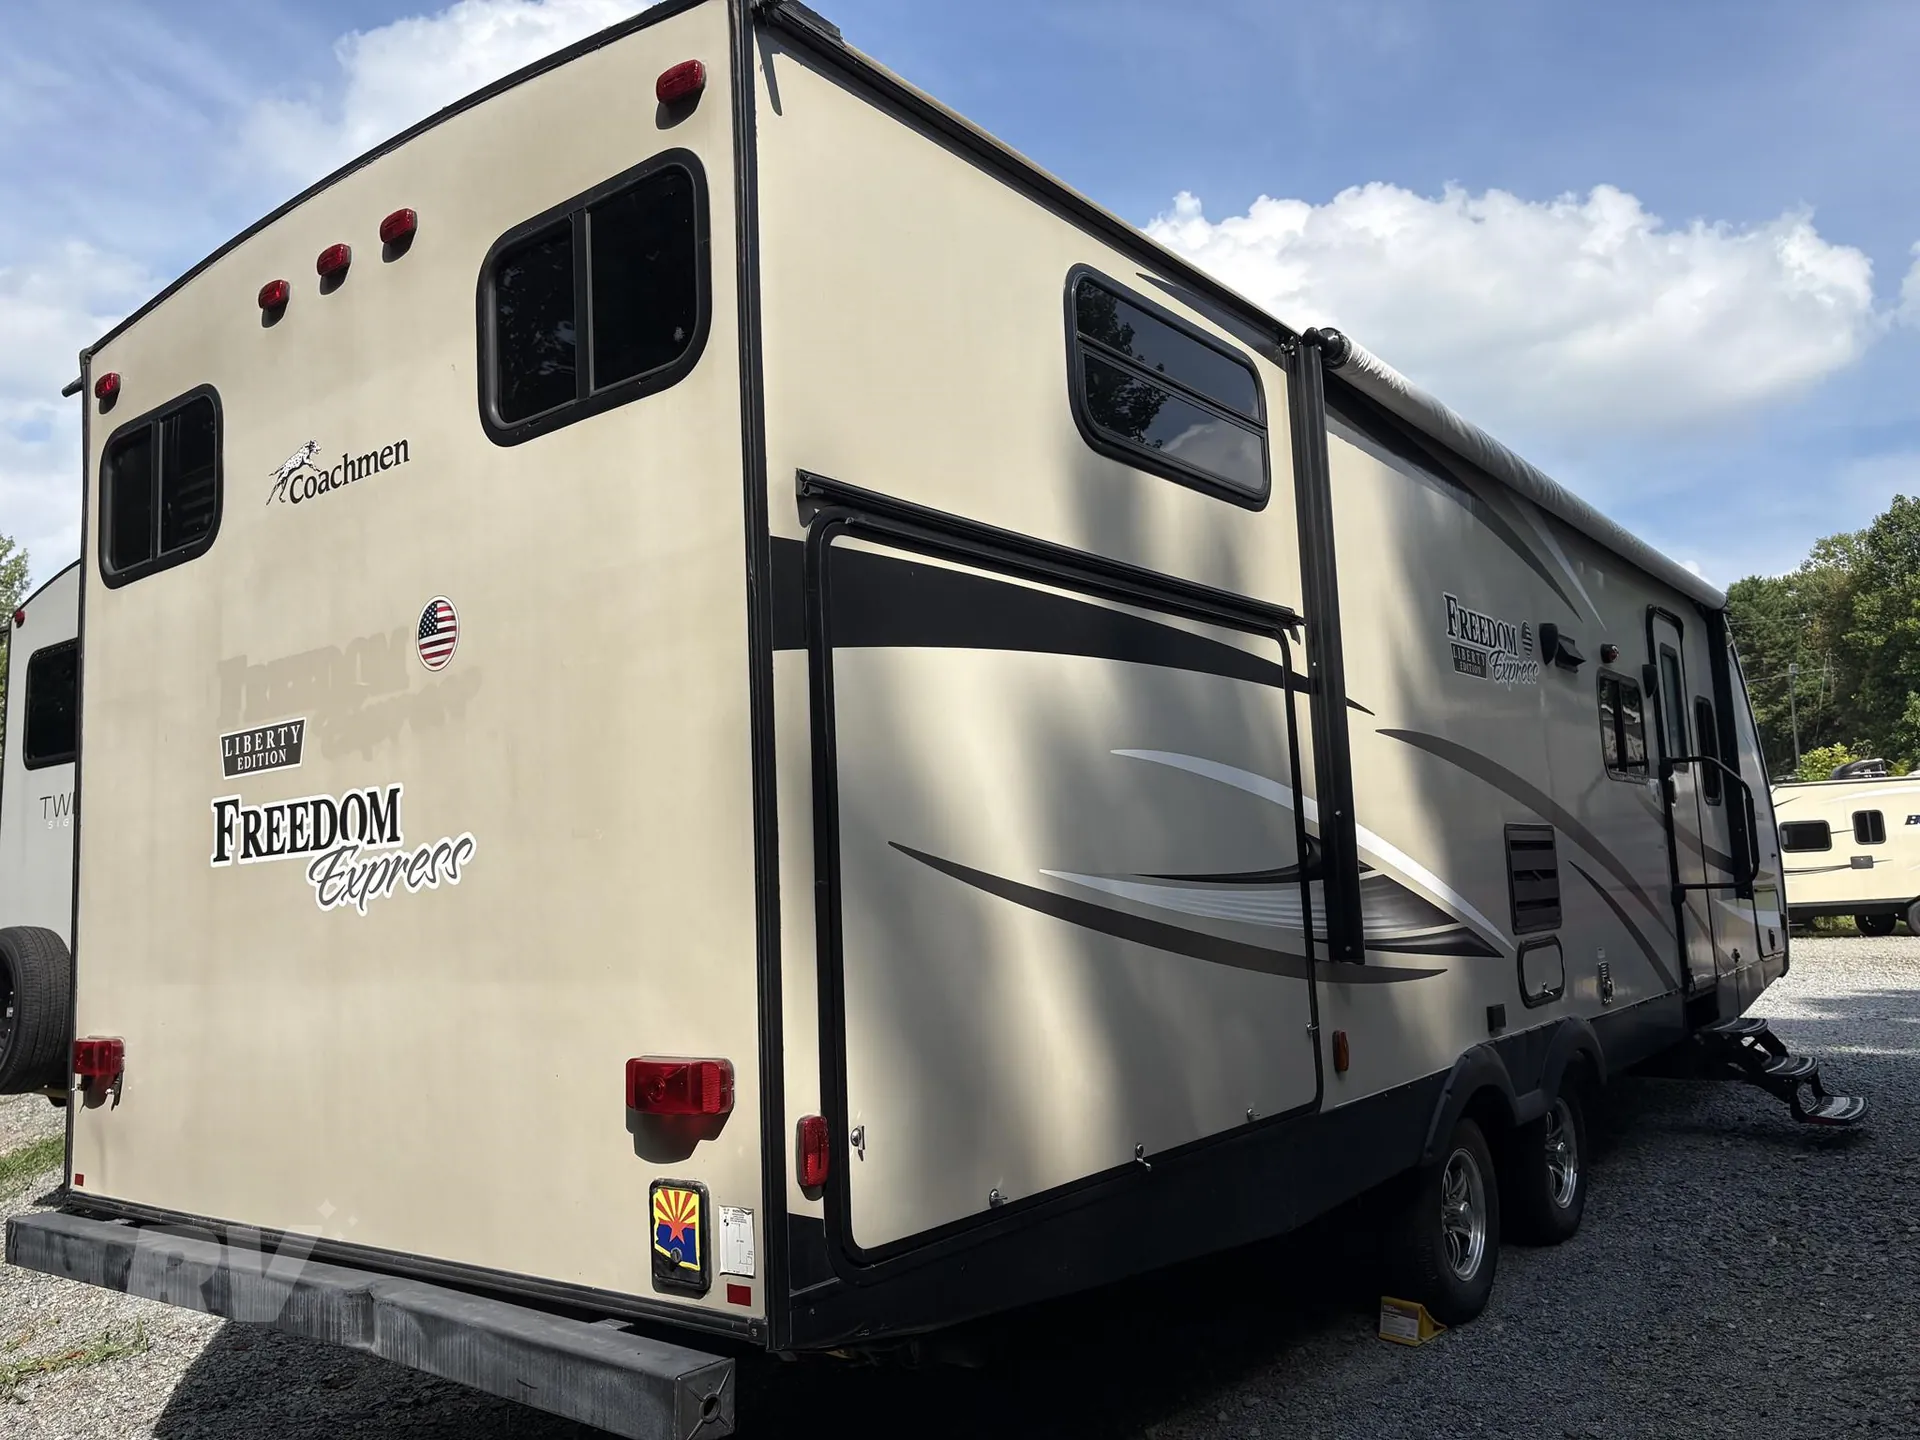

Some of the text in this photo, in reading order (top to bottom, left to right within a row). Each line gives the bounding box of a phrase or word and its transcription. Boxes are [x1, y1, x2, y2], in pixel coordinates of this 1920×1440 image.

[289, 439, 410, 504] Coachmen
[1443, 594, 1519, 657] FREEDOM
[1451, 644, 1487, 666] LIBERTY
[1488, 649, 1539, 688] Express
[224, 724, 301, 757] LIBERTY
[237, 749, 287, 771] EDITION
[39, 792, 75, 819] TW
[213, 787, 401, 863] FREEDOM
[308, 837, 473, 912] Express
